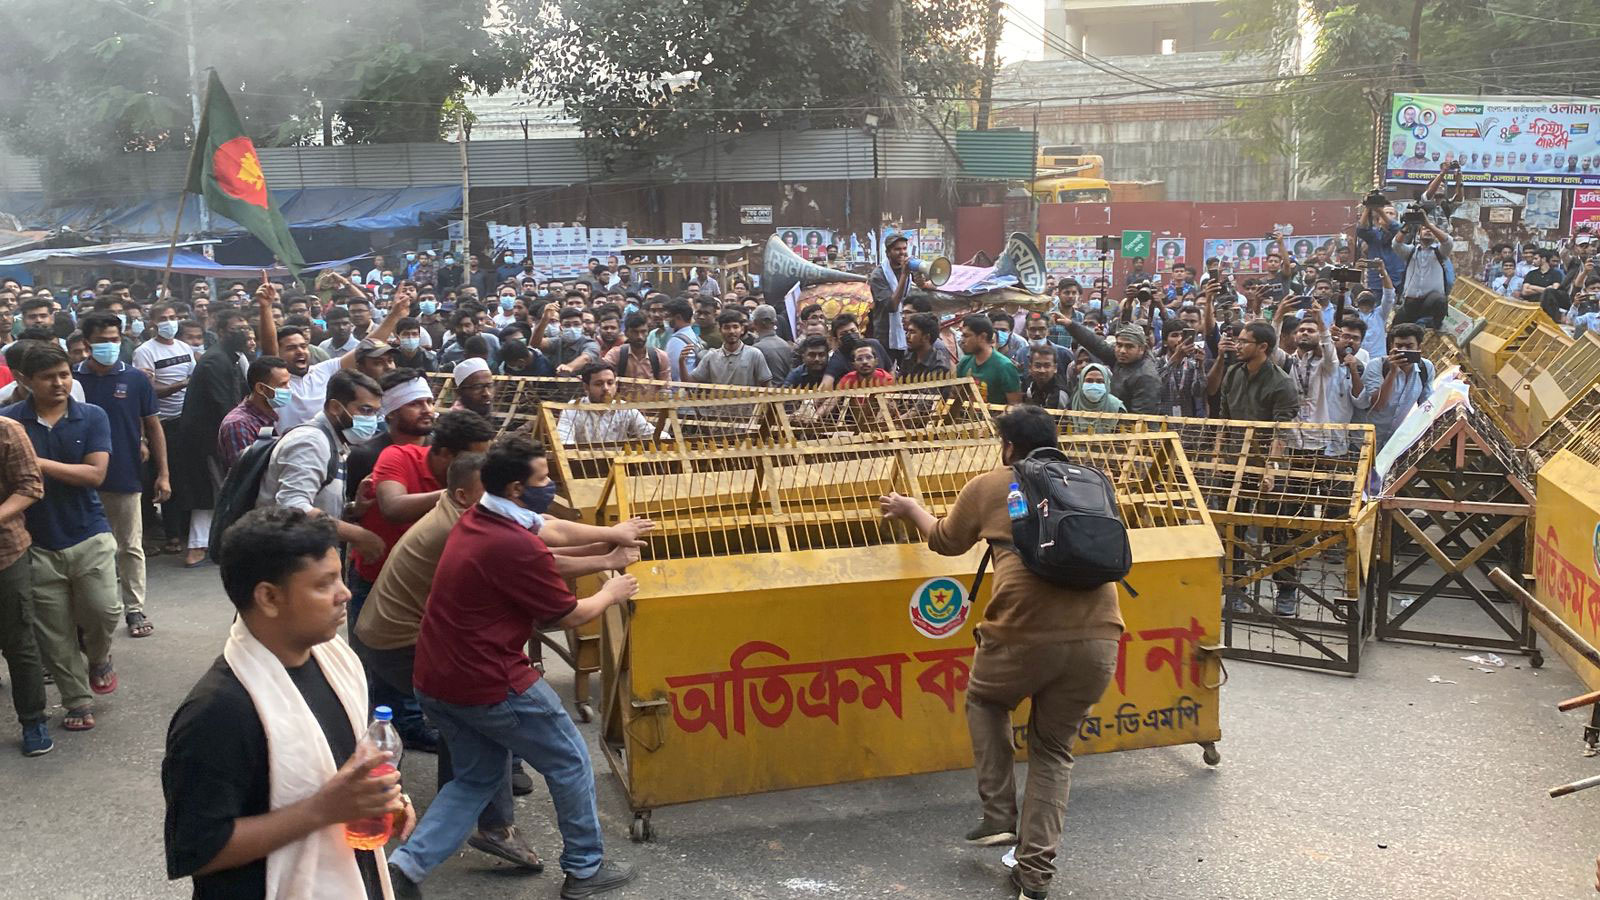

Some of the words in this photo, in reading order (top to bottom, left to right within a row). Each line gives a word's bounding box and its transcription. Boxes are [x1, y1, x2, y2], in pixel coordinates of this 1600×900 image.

[1549, 104, 1586, 115] ওলামা
[664, 640, 910, 740] অতিক্রম
[1136, 615, 1207, 690] না
